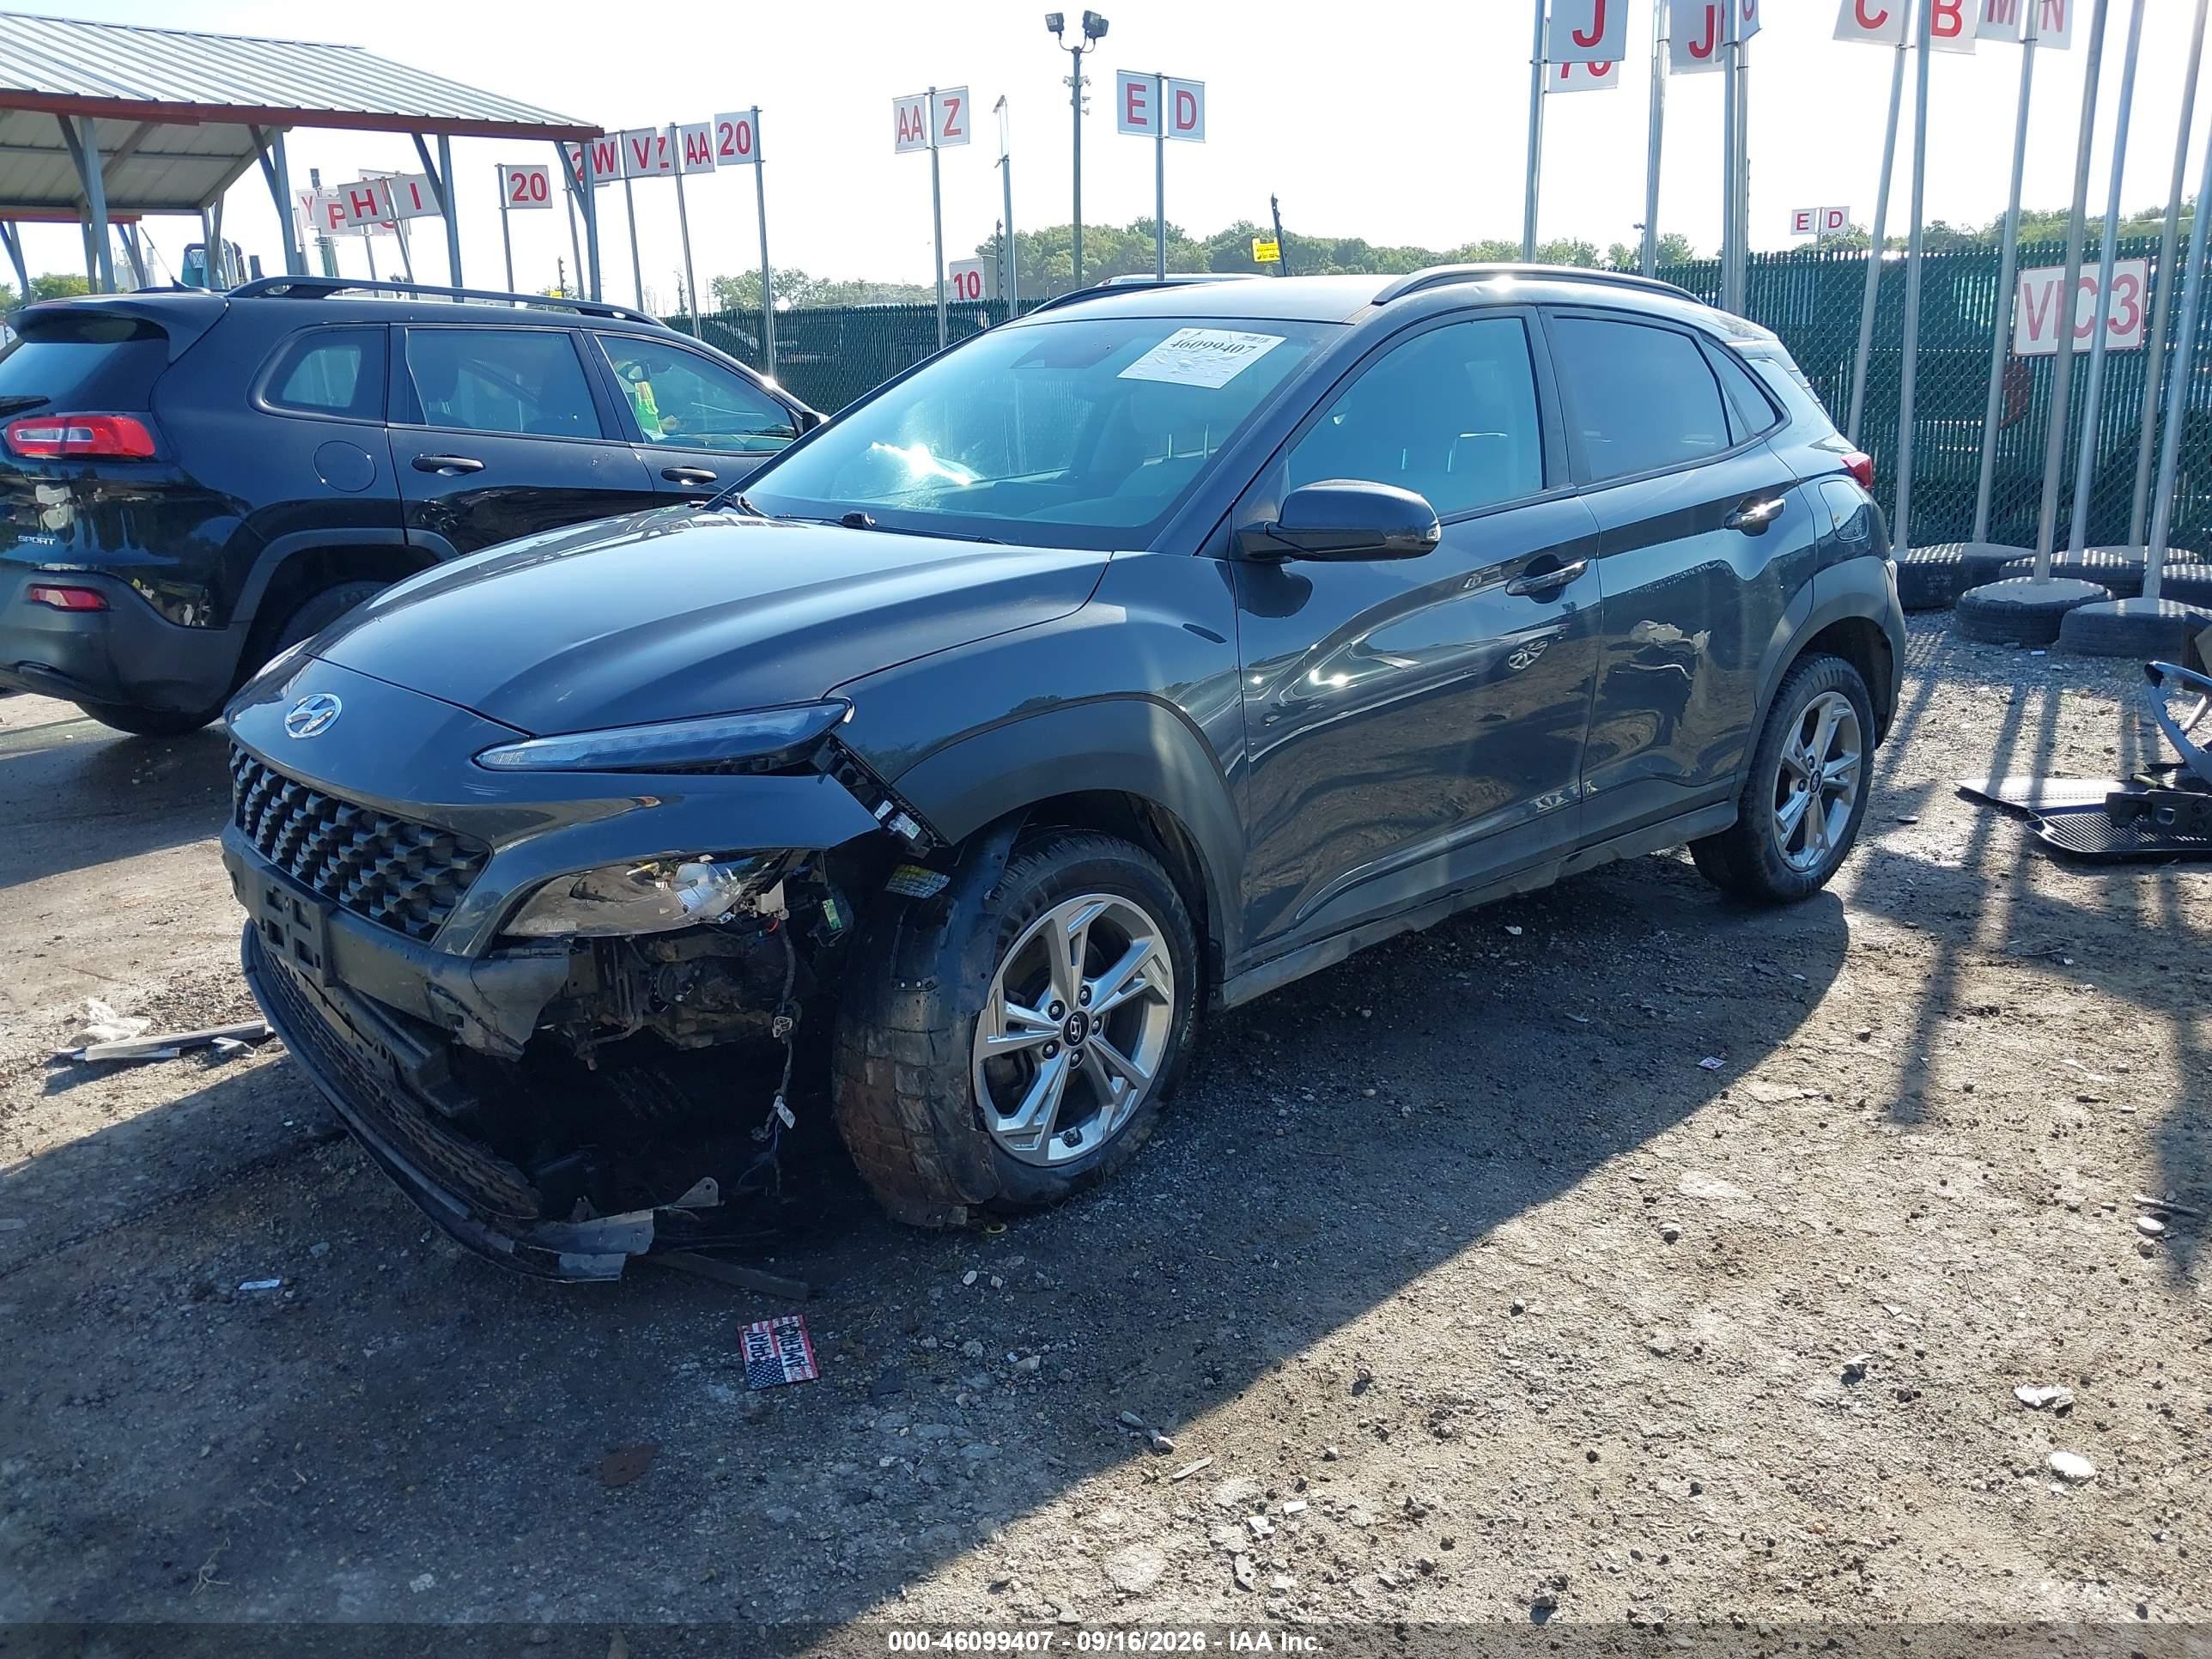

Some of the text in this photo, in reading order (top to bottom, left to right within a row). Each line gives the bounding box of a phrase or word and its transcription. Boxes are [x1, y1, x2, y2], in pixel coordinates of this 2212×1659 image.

[1571, 0, 1606, 47] J
[1689, 4, 1716, 58] J
[943, 98, 962, 137] Z
[1127, 82, 1148, 126] E
[1176, 89, 1197, 131] D
[718, 120, 751, 156] 20
[897, 105, 925, 144] AA
[591, 141, 616, 174] W
[631, 137, 651, 169] V
[686, 131, 712, 166] AA
[349, 188, 379, 218] H
[510, 172, 547, 202] 20
[301, 195, 314, 222] Y
[1796, 212, 1810, 231] E
[1827, 210, 1844, 229] D
[953, 270, 981, 301] 10
[1170, 338, 1258, 356] 46099407
[17, 535, 56, 545] SPORT
[746, 1332, 772, 1358] PRAY
[775, 1322, 809, 1368] AMERICA
